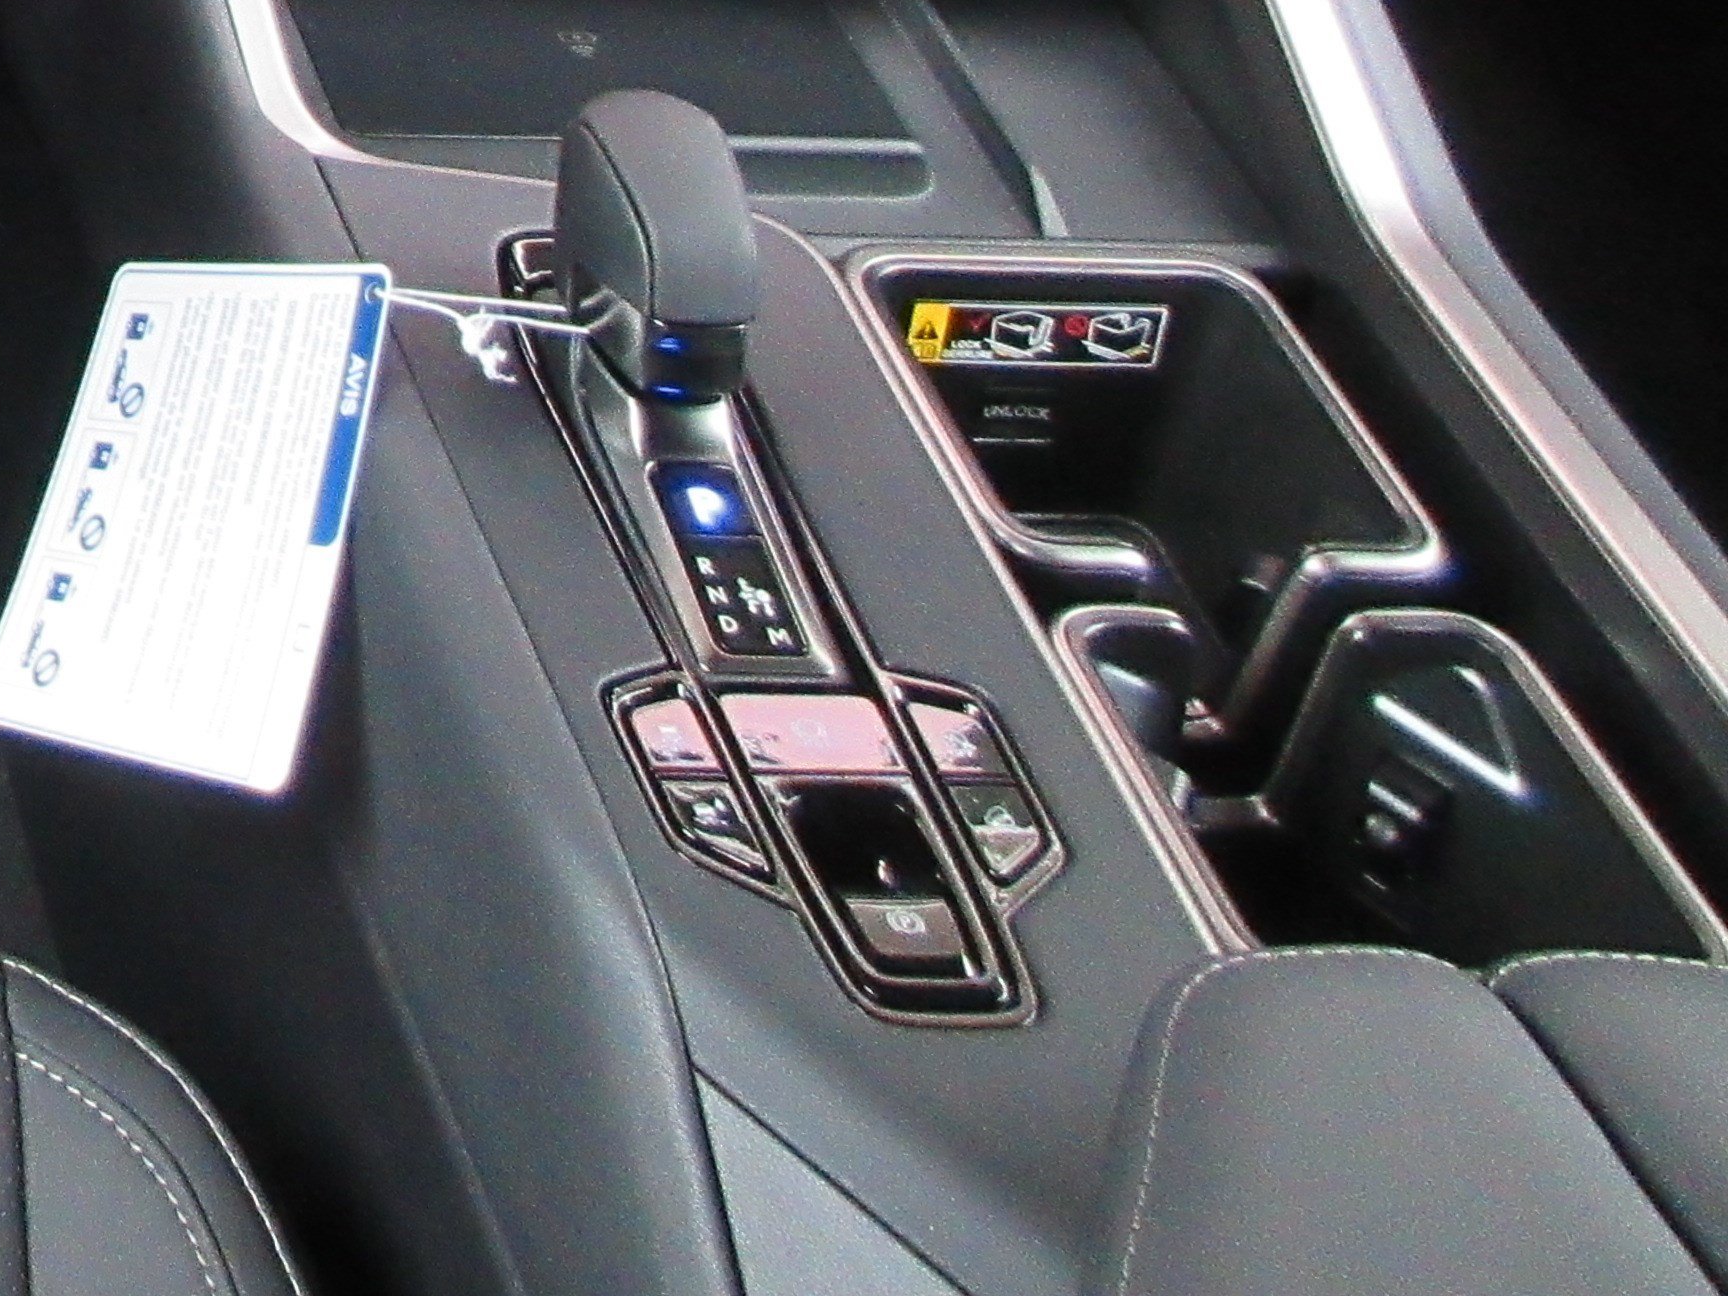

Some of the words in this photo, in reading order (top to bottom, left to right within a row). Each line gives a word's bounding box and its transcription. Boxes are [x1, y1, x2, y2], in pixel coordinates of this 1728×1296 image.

[339, 351, 371, 418] AVIS
[983, 405, 1051, 420] UNLOCK
[685, 486, 725, 529] P
[696, 556, 717, 579] R
[707, 585, 728, 605] N
[718, 614, 739, 633] D
[766, 626, 793, 646] M
